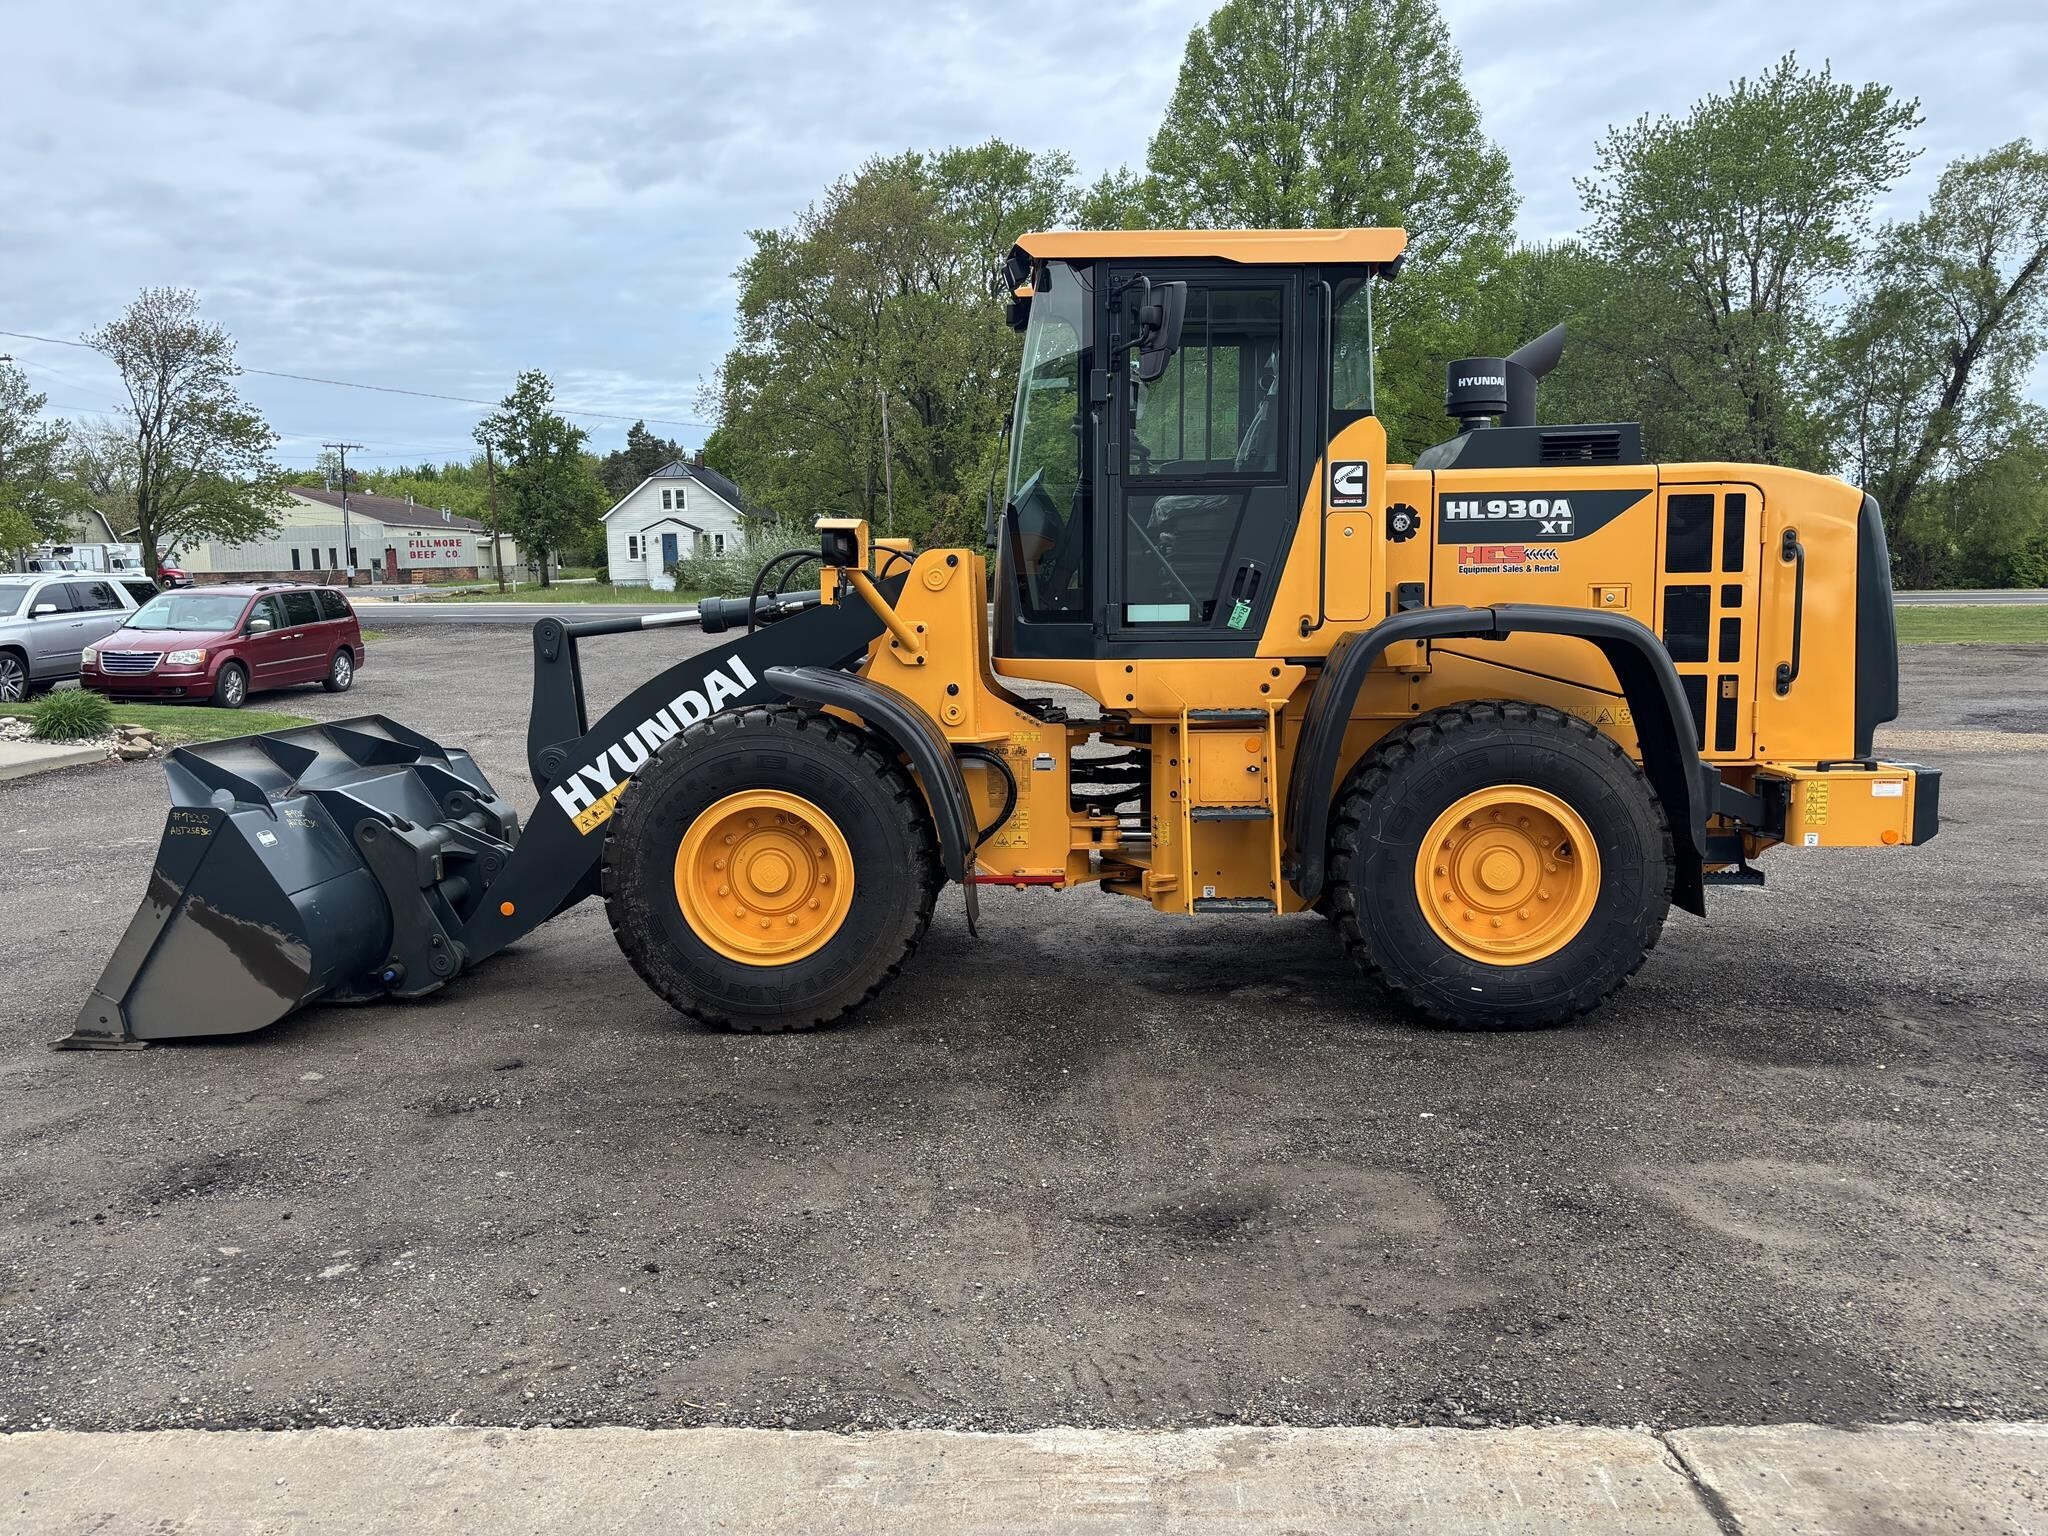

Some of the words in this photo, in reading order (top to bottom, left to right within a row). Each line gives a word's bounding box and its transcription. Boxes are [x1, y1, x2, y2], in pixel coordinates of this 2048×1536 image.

[1446, 499, 1573, 519] HL930A
[1540, 521, 1573, 534] XT
[408, 539, 462, 548] FILLMORE
[410, 550, 437, 559] BEEF
[445, 550, 461, 558] CO.
[1458, 546, 1527, 564] HES
[1458, 566, 1500, 574] Equipment
[1502, 565, 1523, 573] Sales
[550, 653, 758, 820] HYUNDAI
